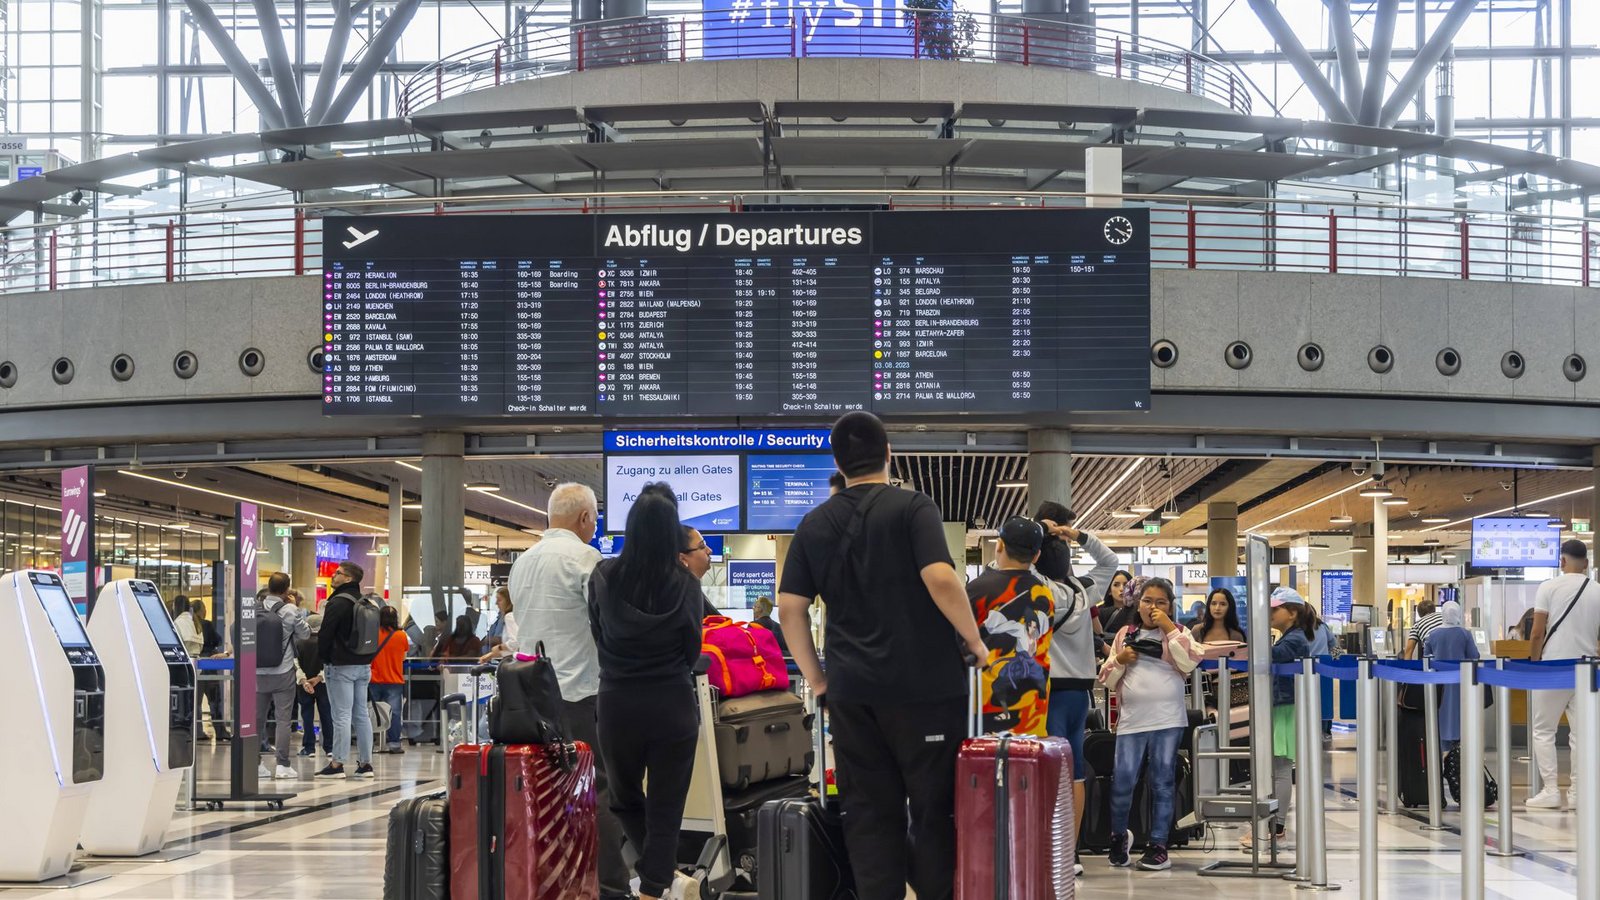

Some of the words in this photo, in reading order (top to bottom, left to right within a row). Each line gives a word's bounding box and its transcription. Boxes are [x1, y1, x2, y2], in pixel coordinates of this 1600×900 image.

[605, 225, 691, 251] Abflug
[698, 223, 709, 247] /
[716, 223, 862, 250] Departures
[640, 269, 657, 277] IZMIR
[915, 298, 937, 306] LONDON
[1012, 297, 1031, 305] 21:10
[639, 321, 664, 329] ZUERICH
[1012, 318, 1031, 326] 22:10
[366, 333, 393, 341] ISTANBUL
[395, 343, 424, 351] MALLORCA
[460, 353, 478, 361] 18:15
[616, 435, 755, 447] Sicherheitskontrolle
[758, 434, 763, 446] /
[767, 435, 824, 448] Security
[616, 465, 656, 478] Zugang
[659, 467, 671, 475] zu
[674, 465, 699, 475] allen
[702, 465, 733, 475] Gates
[677, 492, 688, 501] all
[691, 492, 722, 501] Gates
